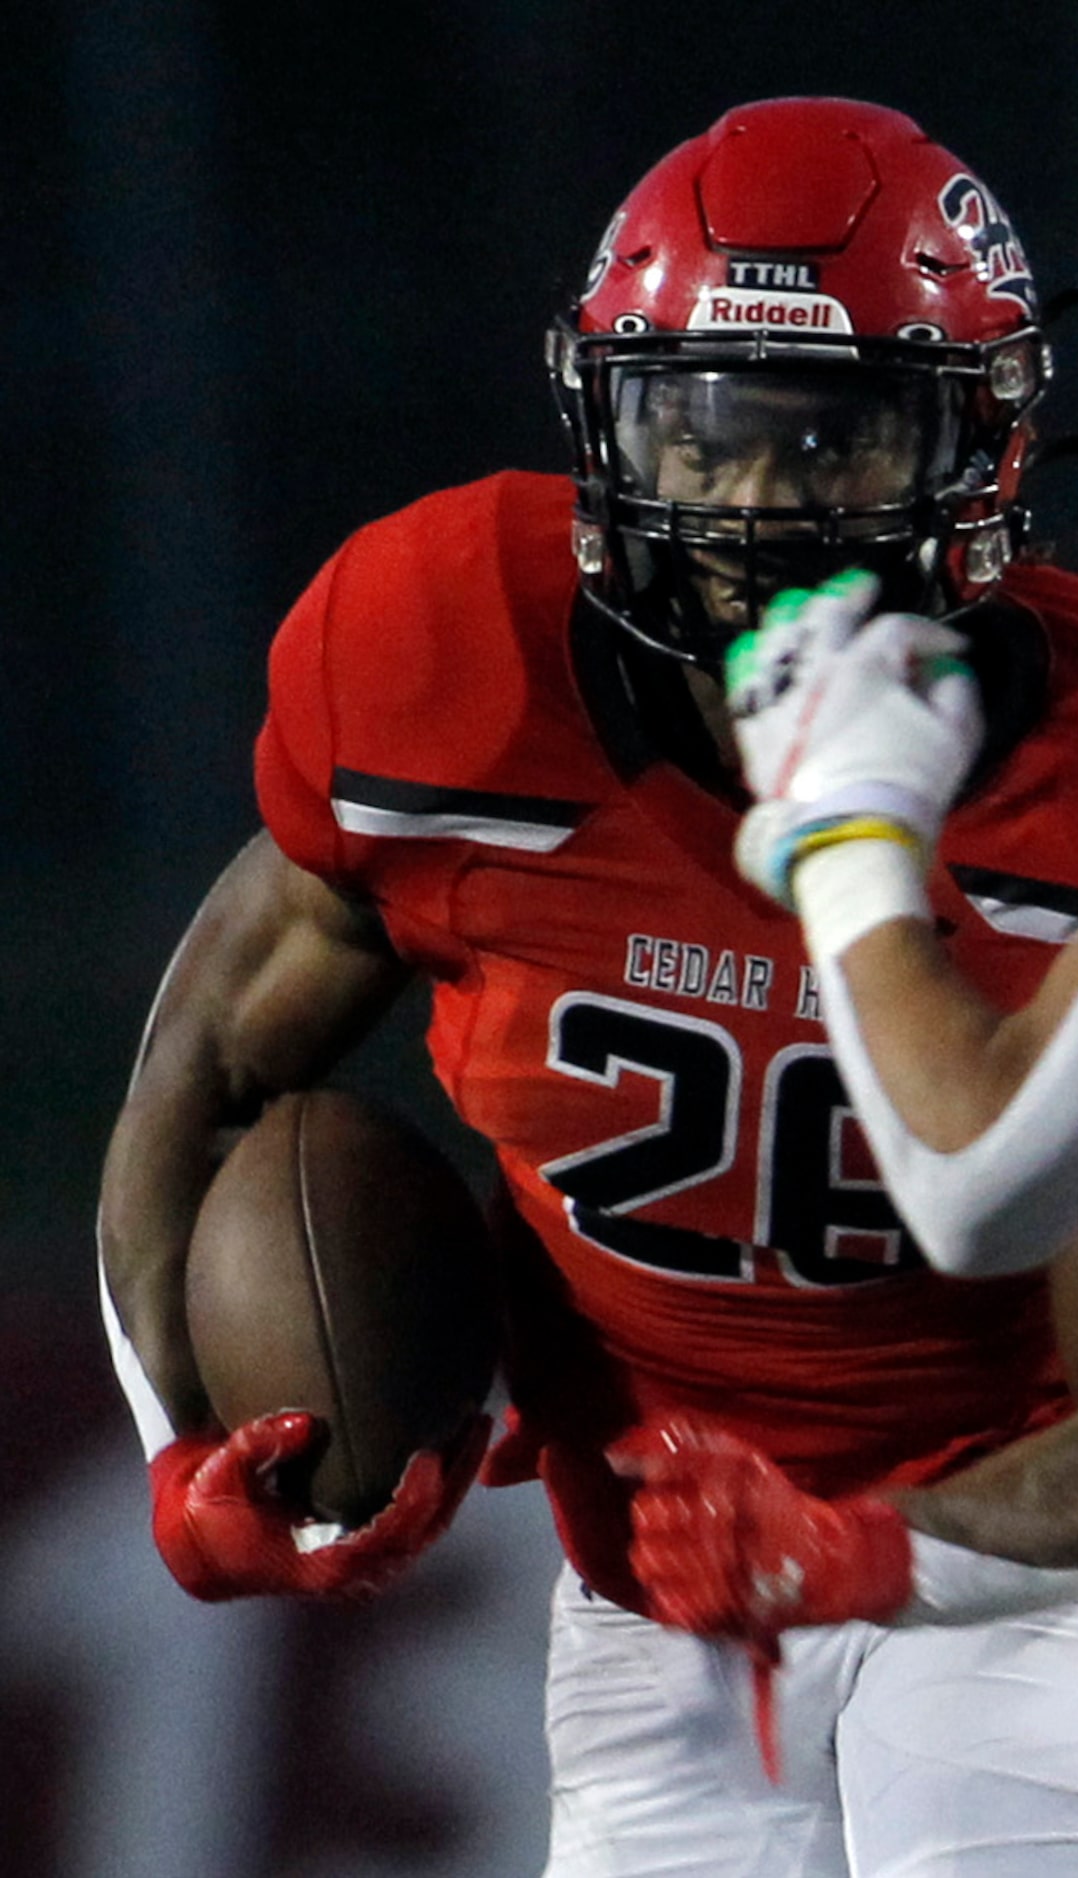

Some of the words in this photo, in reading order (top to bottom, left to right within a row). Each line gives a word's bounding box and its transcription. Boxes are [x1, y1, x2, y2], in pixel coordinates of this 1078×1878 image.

[730, 262, 816, 289] TTHL
[710, 298, 831, 328] Riddell
[624, 934, 774, 1010] CEDAR
